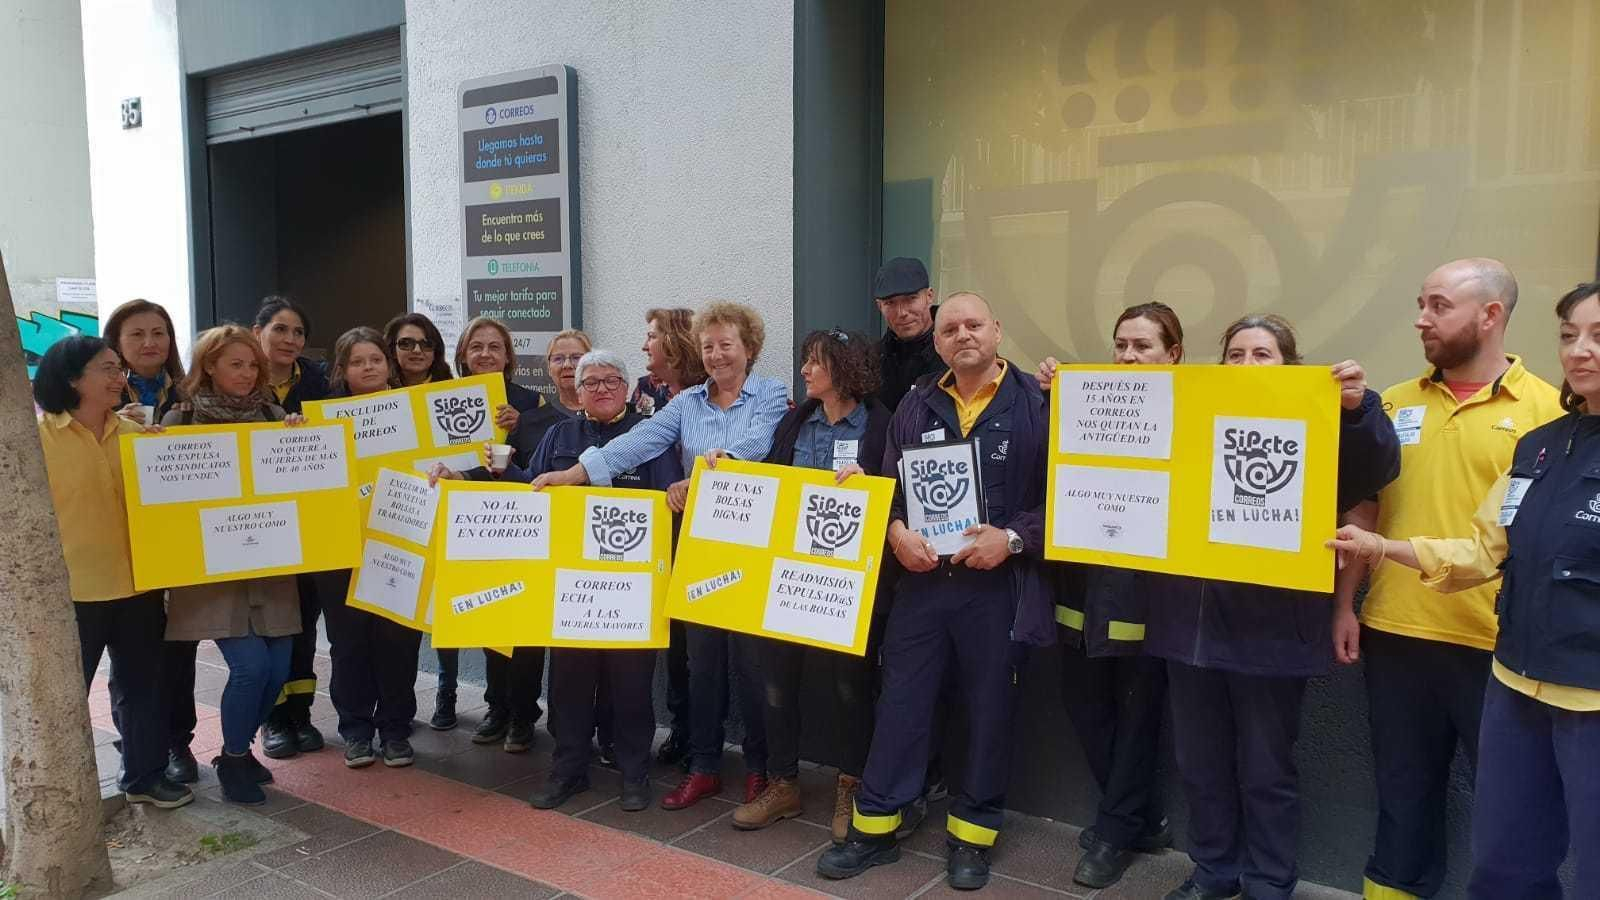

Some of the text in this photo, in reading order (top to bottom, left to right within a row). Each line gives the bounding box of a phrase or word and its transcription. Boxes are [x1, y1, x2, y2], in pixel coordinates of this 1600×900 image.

[499, 104, 535, 119] CORREOS
[478, 133, 544, 153] Llegamos hasta
[475, 151, 548, 169] donde tú quieras
[481, 210, 544, 226] Encuentra más
[481, 229, 545, 245] de lo que crees
[472, 287, 557, 304] Tu mejor tarifa para
[480, 304, 551, 319] seguir conectado
[513, 364, 544, 377] víos en
[520, 382, 557, 394] omento
[1081, 379, 1150, 392] DESPUÉS DE
[1085, 392, 1145, 405] 15 AÑOS EN
[335, 400, 400, 419] EXCLUIDOS
[1089, 407, 1141, 418] CORREOS
[362, 416, 377, 427] DE
[1076, 419, 1158, 432] NOS QUITAN LA
[278, 434, 322, 444] CORREOS
[352, 425, 398, 440] ORREOS
[1079, 430, 1152, 445] ANTIGÜEDAD
[166, 441, 213, 451] CORREOS
[270, 443, 328, 456] NO QUIERE A
[156, 452, 221, 462] NOS EXPULSA
[260, 451, 339, 466] MUJERES DE MÁS
[991, 452, 1007, 462] Corr
[146, 461, 232, 473] Y LOS SINDICATOS
[275, 462, 326, 475] DE 40 AÑOS
[159, 471, 221, 483] NOS VENDEN
[389, 478, 419, 493] EXCLUIR
[711, 479, 764, 496] POR UNAS
[387, 488, 427, 507] LAS NUEVAS
[714, 495, 754, 509] BOLSAS
[1064, 489, 1160, 505] ALGO MUY NUESTRO
[1234, 494, 1266, 507] CORREOS
[390, 501, 415, 515] BOLSAS
[481, 500, 519, 511] NO AL
[1097, 503, 1126, 513] COMO
[227, 510, 275, 523] ALGO MUY
[377, 507, 429, 530] TRABAJADORES
[455, 513, 544, 525] ENCHUFISMO
[712, 509, 752, 523] DIGNAS
[1211, 508, 1300, 522] ¡EN LUCHA!
[1575, 510, 1600, 523] Corr
[213, 519, 287, 534] NUESTRO COMO
[457, 528, 541, 538] EN CORREOS
[383, 551, 413, 567] ALGO MUY
[371, 558, 416, 580] NUESTRO COMO
[574, 579, 633, 591] CORREOS
[686, 569, 742, 601] ¡EN LUCHA!
[780, 568, 856, 591] READMISIÓN
[453, 581, 523, 615] ¡EN LUCHA!
[560, 592, 595, 605] ECHA
[776, 583, 854, 607] EXPULSAD@S
[583, 608, 621, 619] A LAS
[779, 600, 848, 620] DE LAS BOLSAS
[559, 620, 644, 630] MUJERES MAYORES
